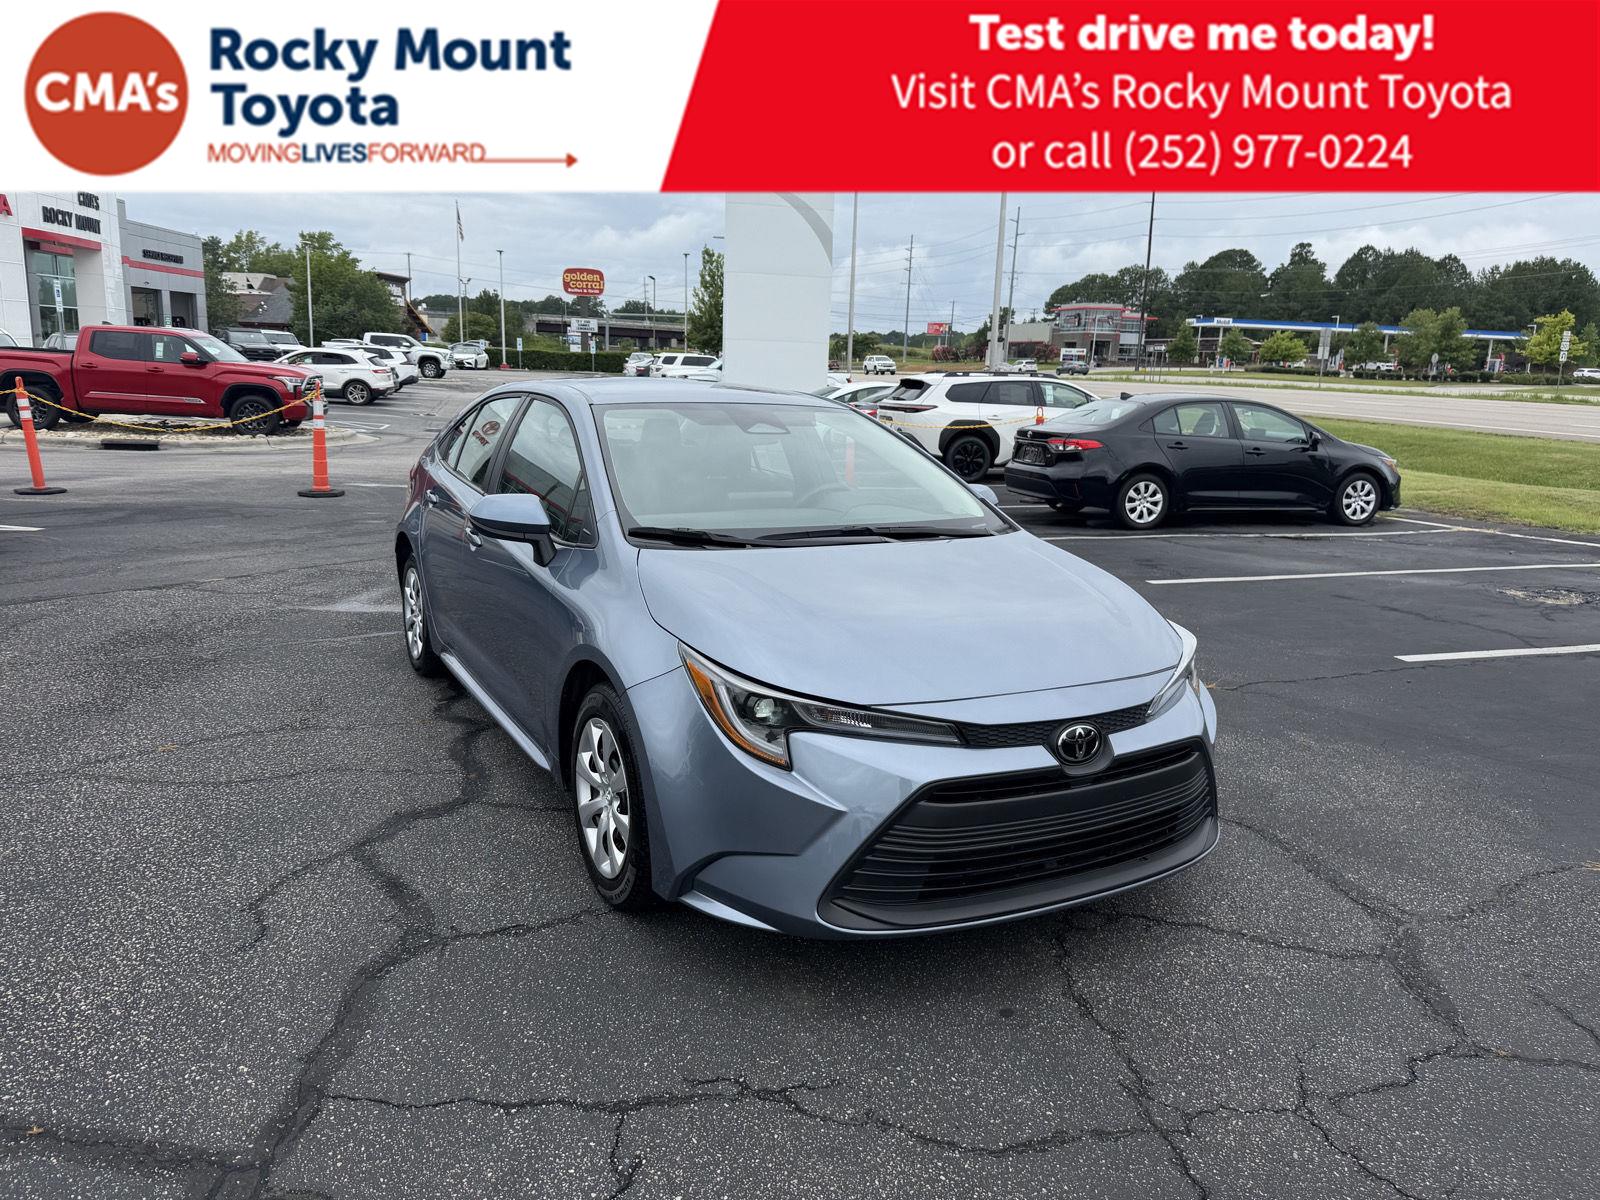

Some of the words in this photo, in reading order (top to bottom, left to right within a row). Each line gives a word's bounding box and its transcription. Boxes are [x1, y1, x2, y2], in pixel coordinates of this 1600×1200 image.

[42, 206, 73, 228] ROCKY
[75, 214, 101, 235] MOUNT
[564, 272, 600, 282] golden
